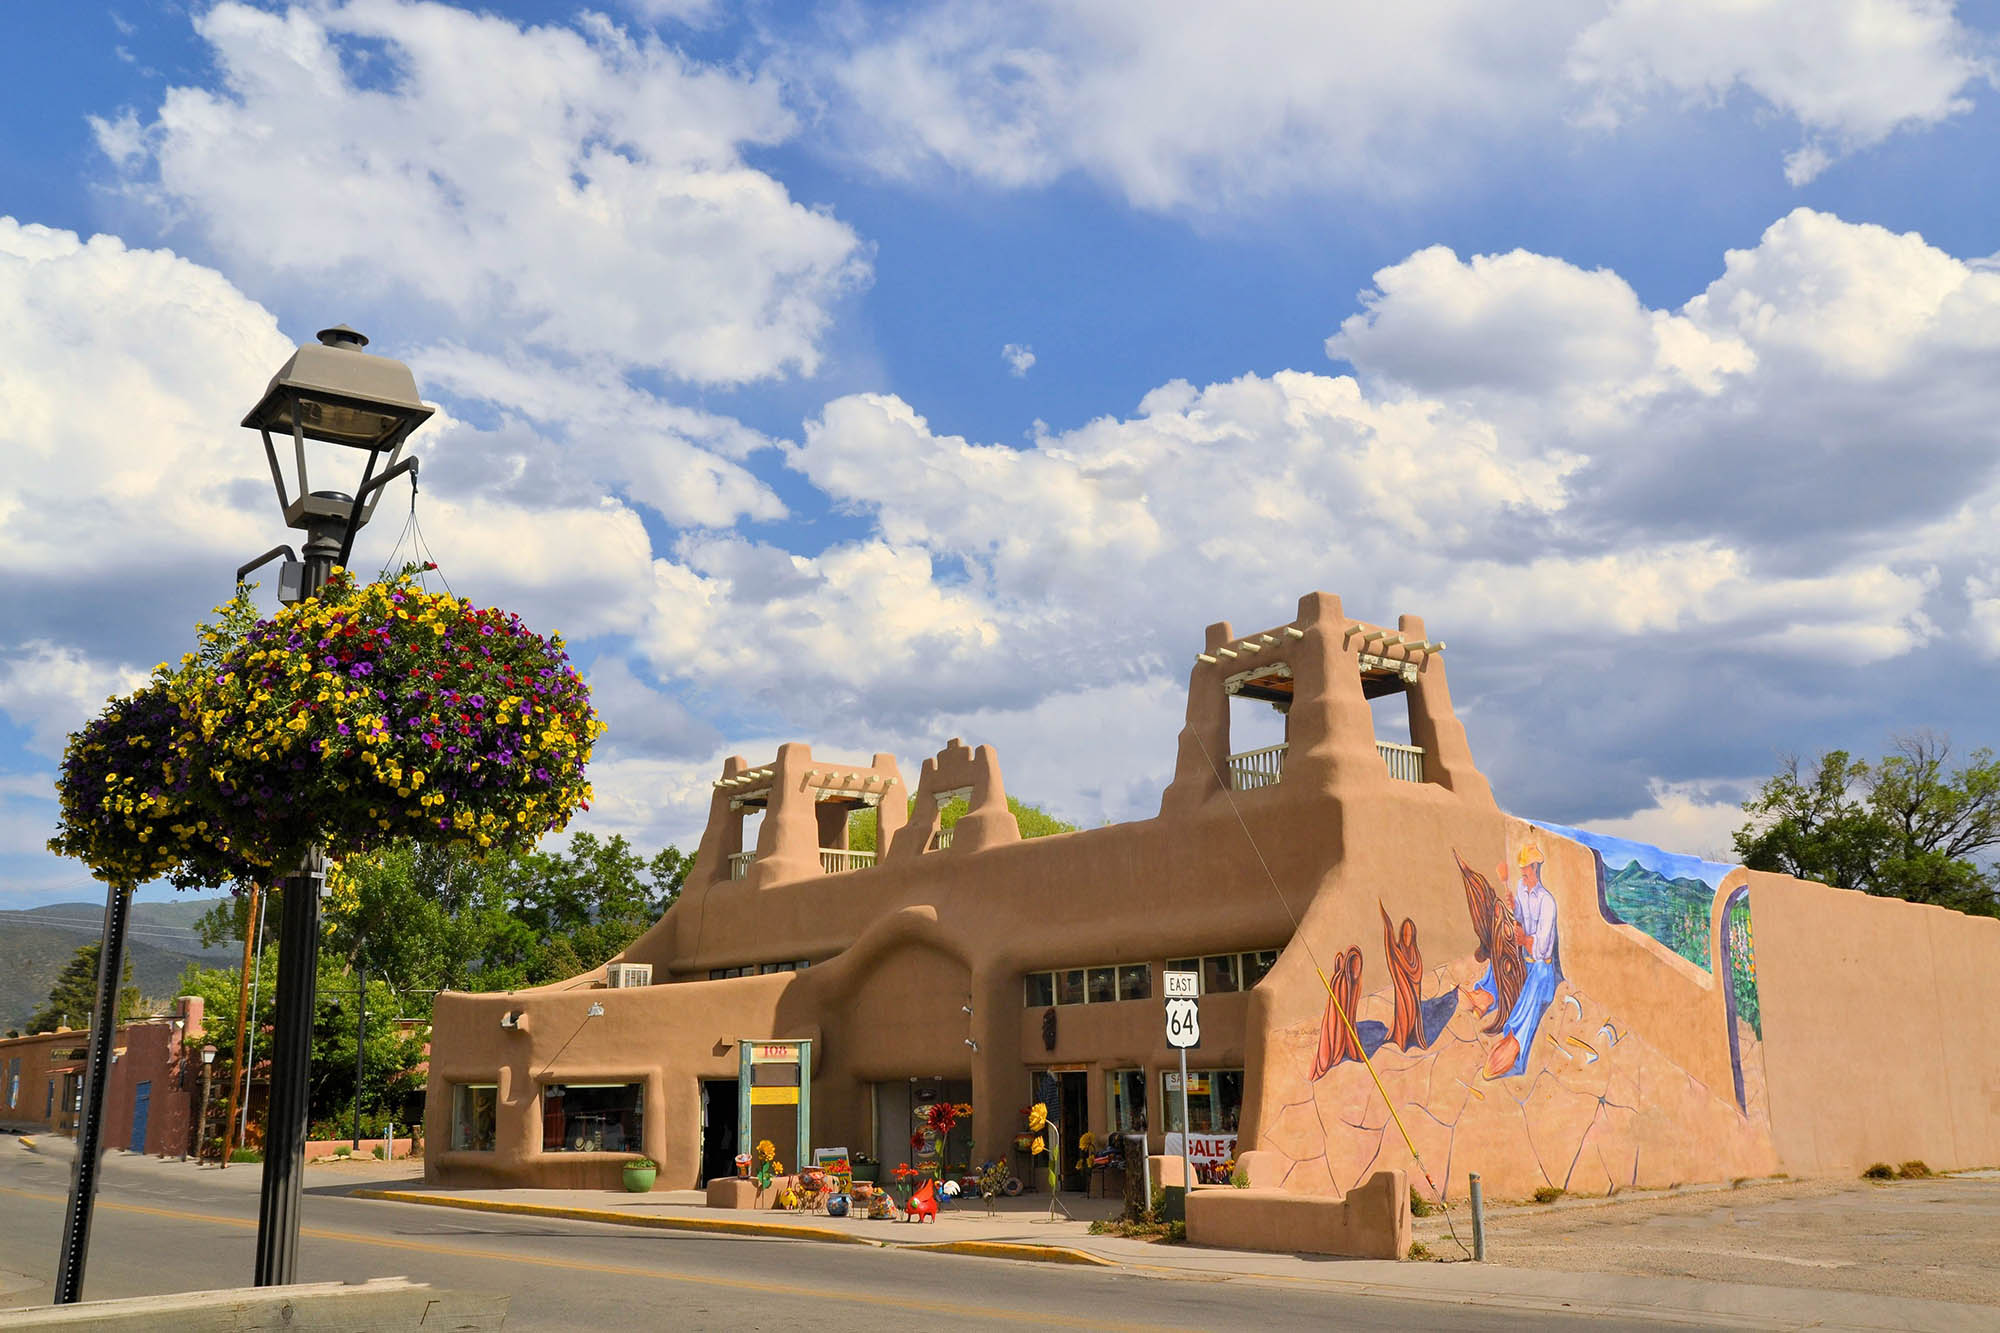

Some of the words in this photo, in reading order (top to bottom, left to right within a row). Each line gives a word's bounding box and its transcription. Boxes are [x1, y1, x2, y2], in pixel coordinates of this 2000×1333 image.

[1169, 977, 1192, 992] EAST
[1171, 1009, 1193, 1036] 64
[764, 1045, 787, 1057] 108
[1170, 1073, 1193, 1083] SAE
